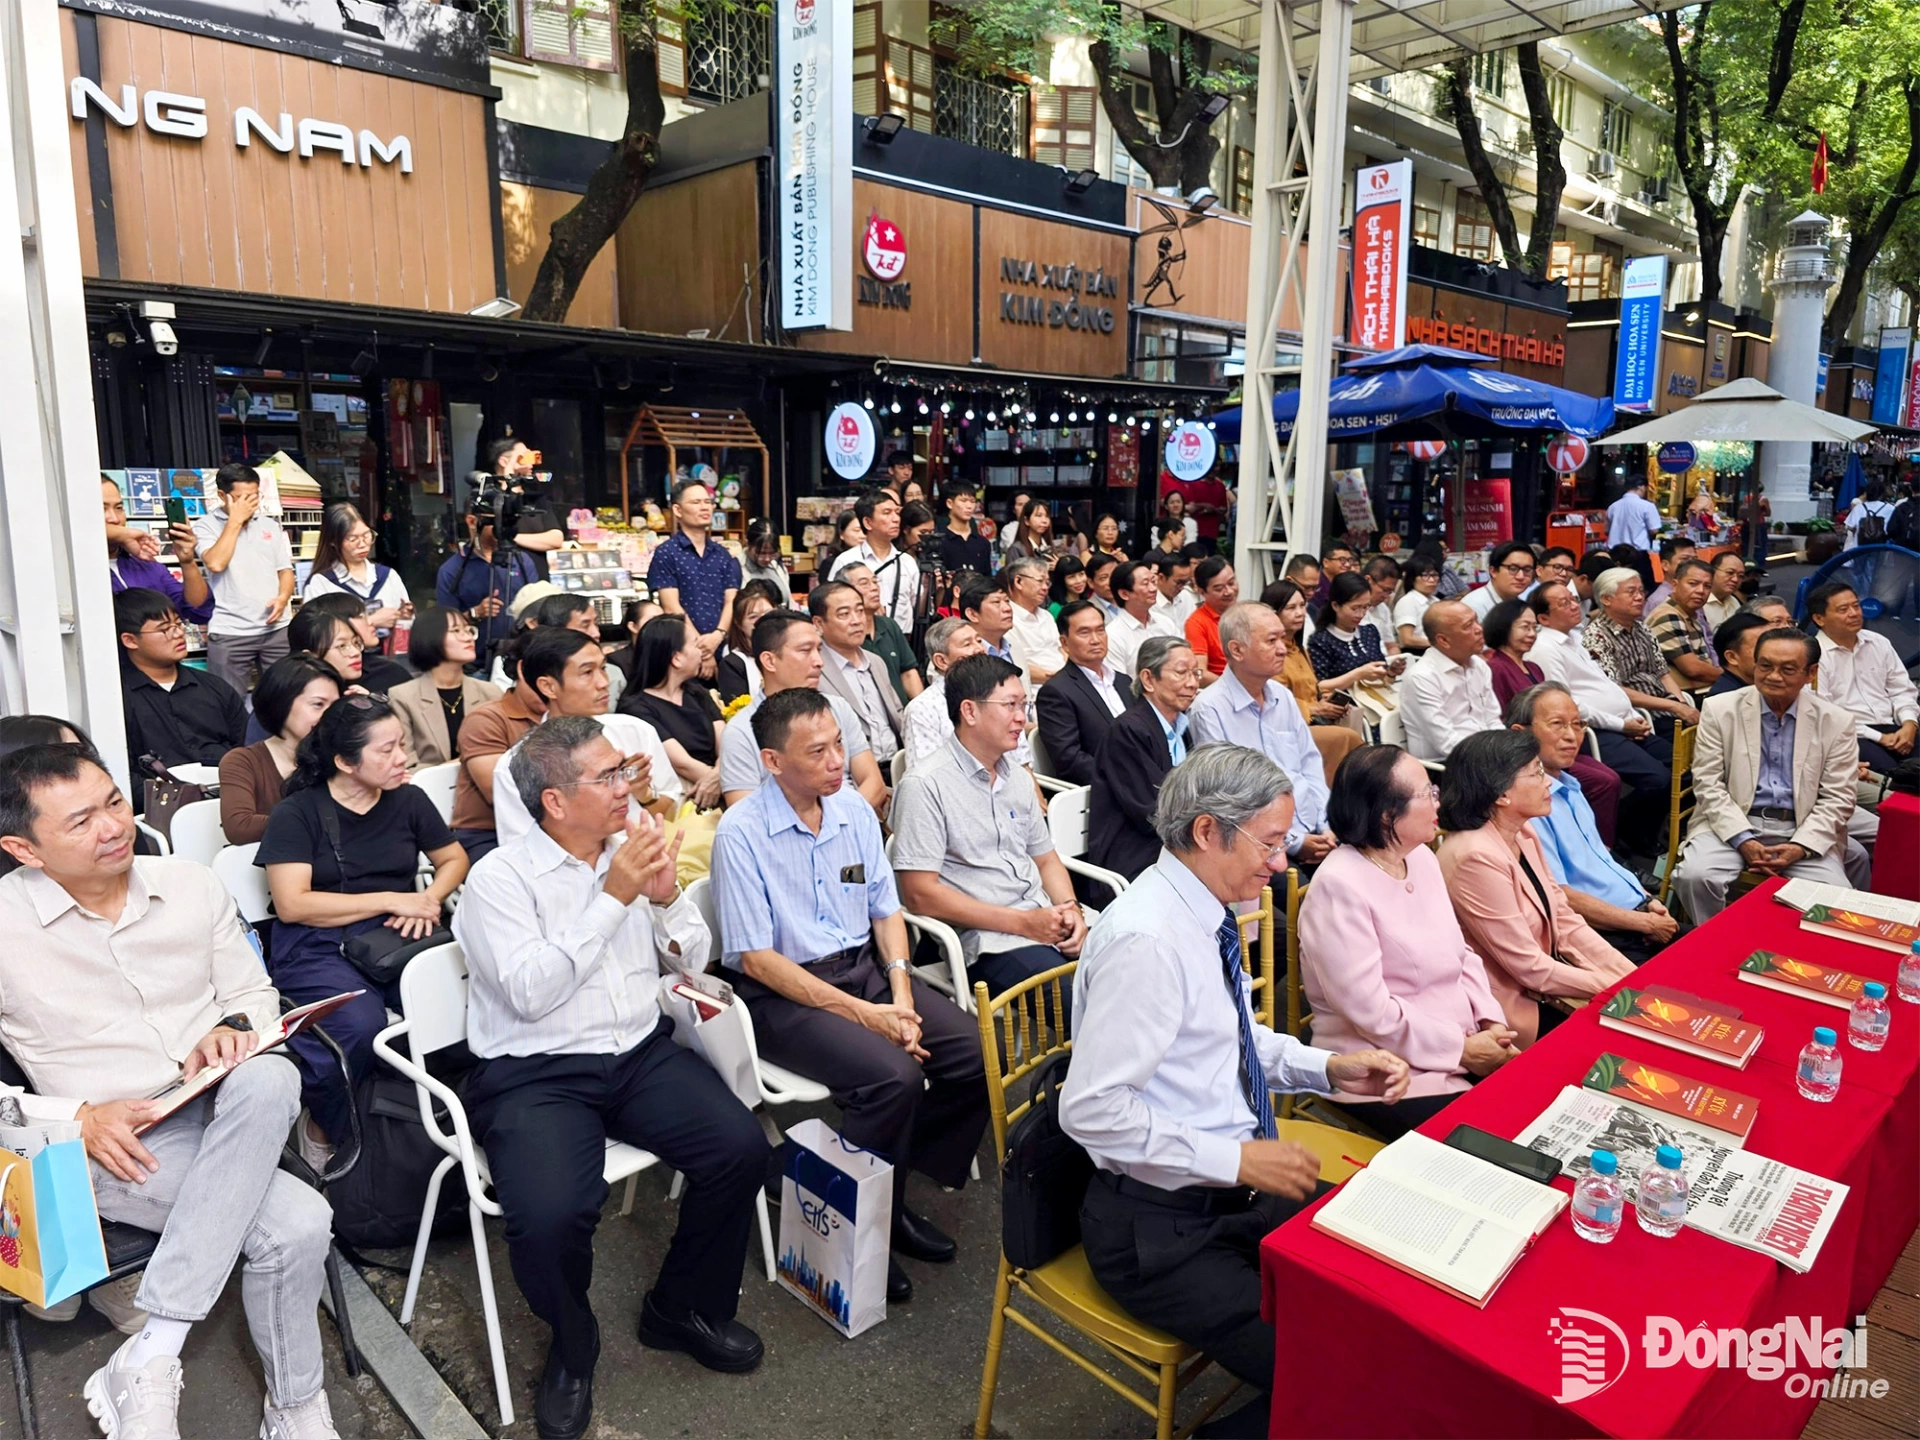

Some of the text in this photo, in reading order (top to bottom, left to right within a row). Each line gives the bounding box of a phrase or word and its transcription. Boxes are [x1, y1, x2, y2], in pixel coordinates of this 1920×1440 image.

[235, 106, 414, 174] NAM
[791, 131, 803, 167] KIM
[790, 174, 804, 214] BẢN
[806, 57, 818, 316] KIM DONG PUBLISHING HOUSE
[790, 221, 804, 269] XUẤT
[1365, 214, 1381, 247] HÀ
[858, 274, 881, 306] KIM
[1041, 261, 1084, 292] XUẤT
[1085, 265, 1118, 298] BẢN
[1363, 250, 1380, 299] THÁI
[1378, 229, 1394, 343] THAIHABOOKS
[1000, 292, 1045, 327] KIM
[1630, 303, 1641, 325] SEN
[1407, 309, 1565, 367] NHÀ SÁCH THÁI HÀ
[1628, 325, 1640, 351] HOA
[1636, 303, 1651, 399] HOA SEN UNIVERSITY
[1346, 415, 1368, 428] SEN
[1705, 1146, 1734, 1173] Nguyên
[1689, 1182, 1710, 1201] 2026
[1696, 1171, 1720, 1186] đán
[1711, 1170, 1744, 1196] Thưởng
[1708, 1193, 1729, 1208] Tết
